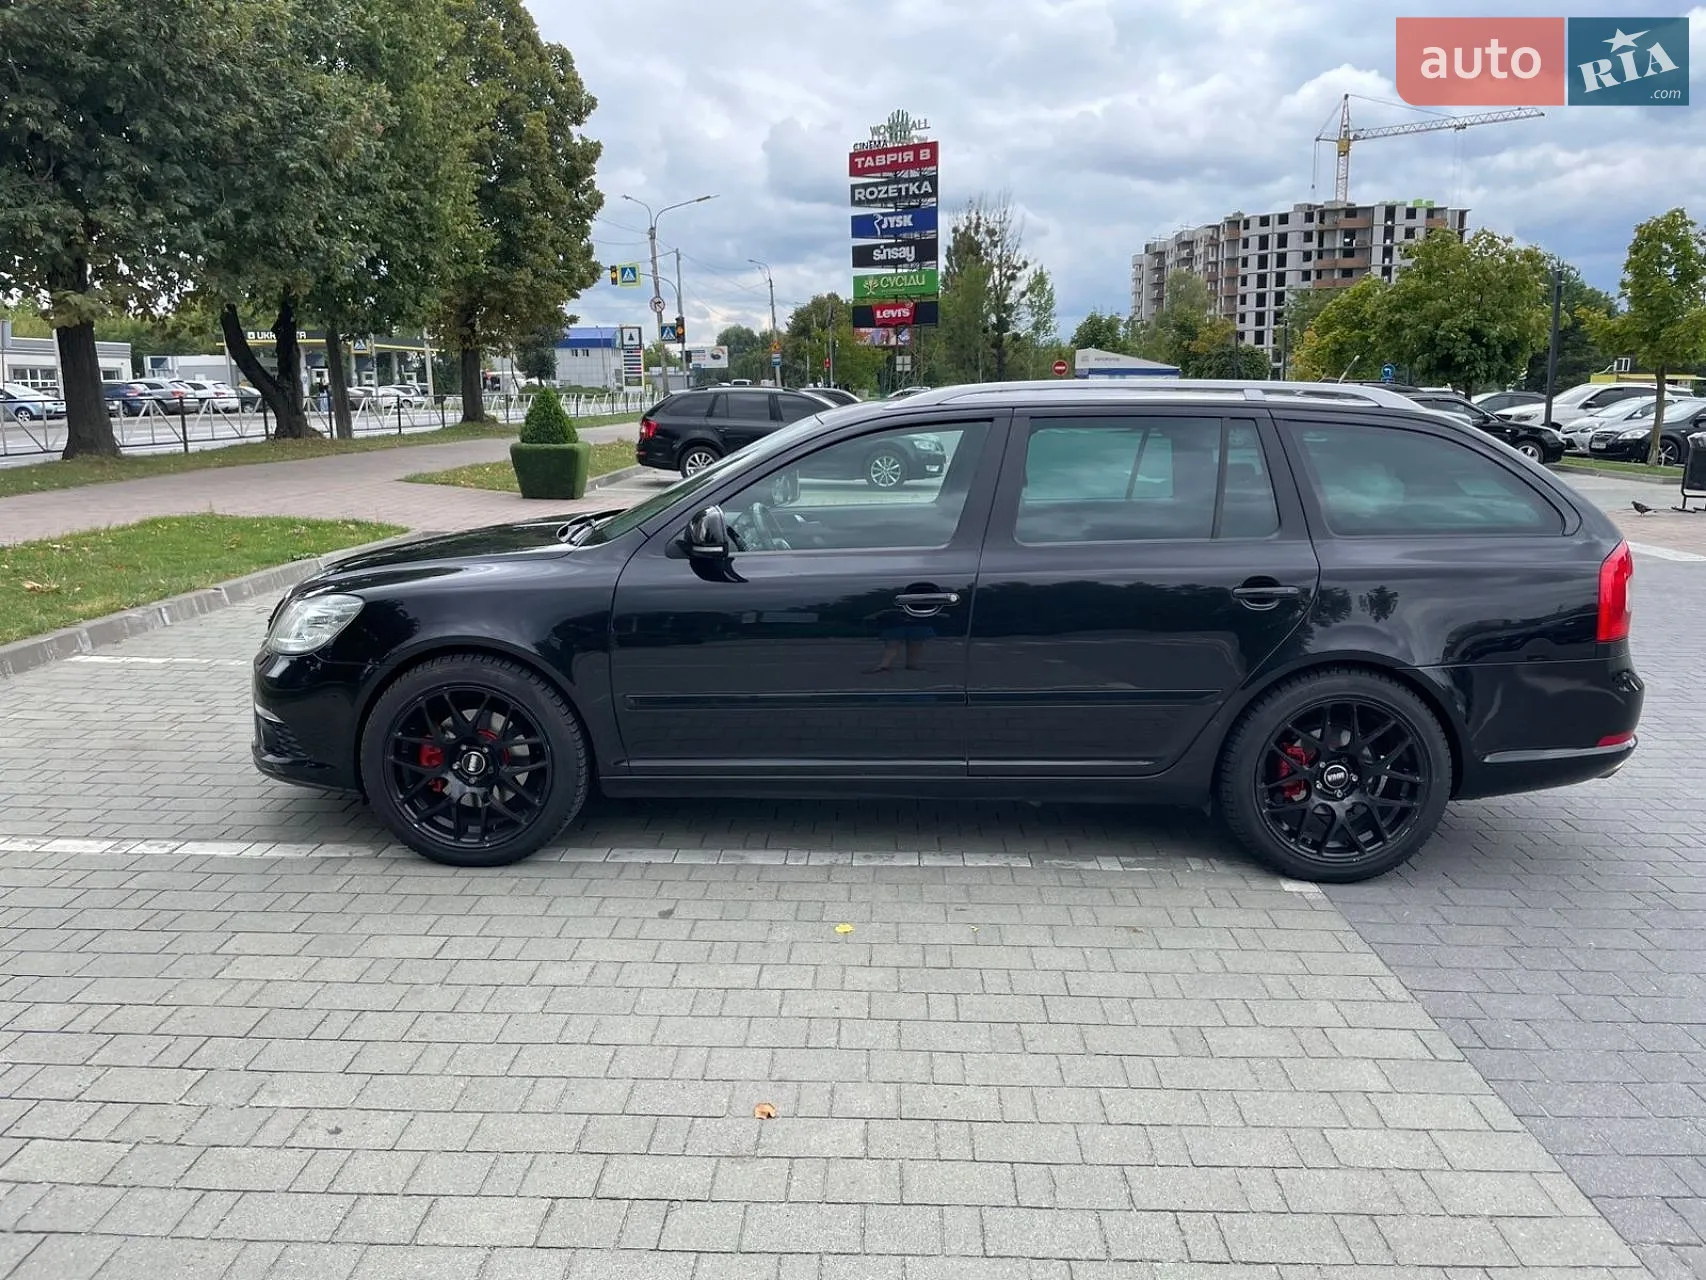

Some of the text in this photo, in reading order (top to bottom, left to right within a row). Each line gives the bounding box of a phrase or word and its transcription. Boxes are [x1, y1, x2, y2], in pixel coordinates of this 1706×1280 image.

[854, 148, 931, 169] ТАВРІЯ В
[854, 180, 932, 201] ROZETKA
[881, 214, 914, 229] JYSK
[872, 245, 916, 262] sinsay
